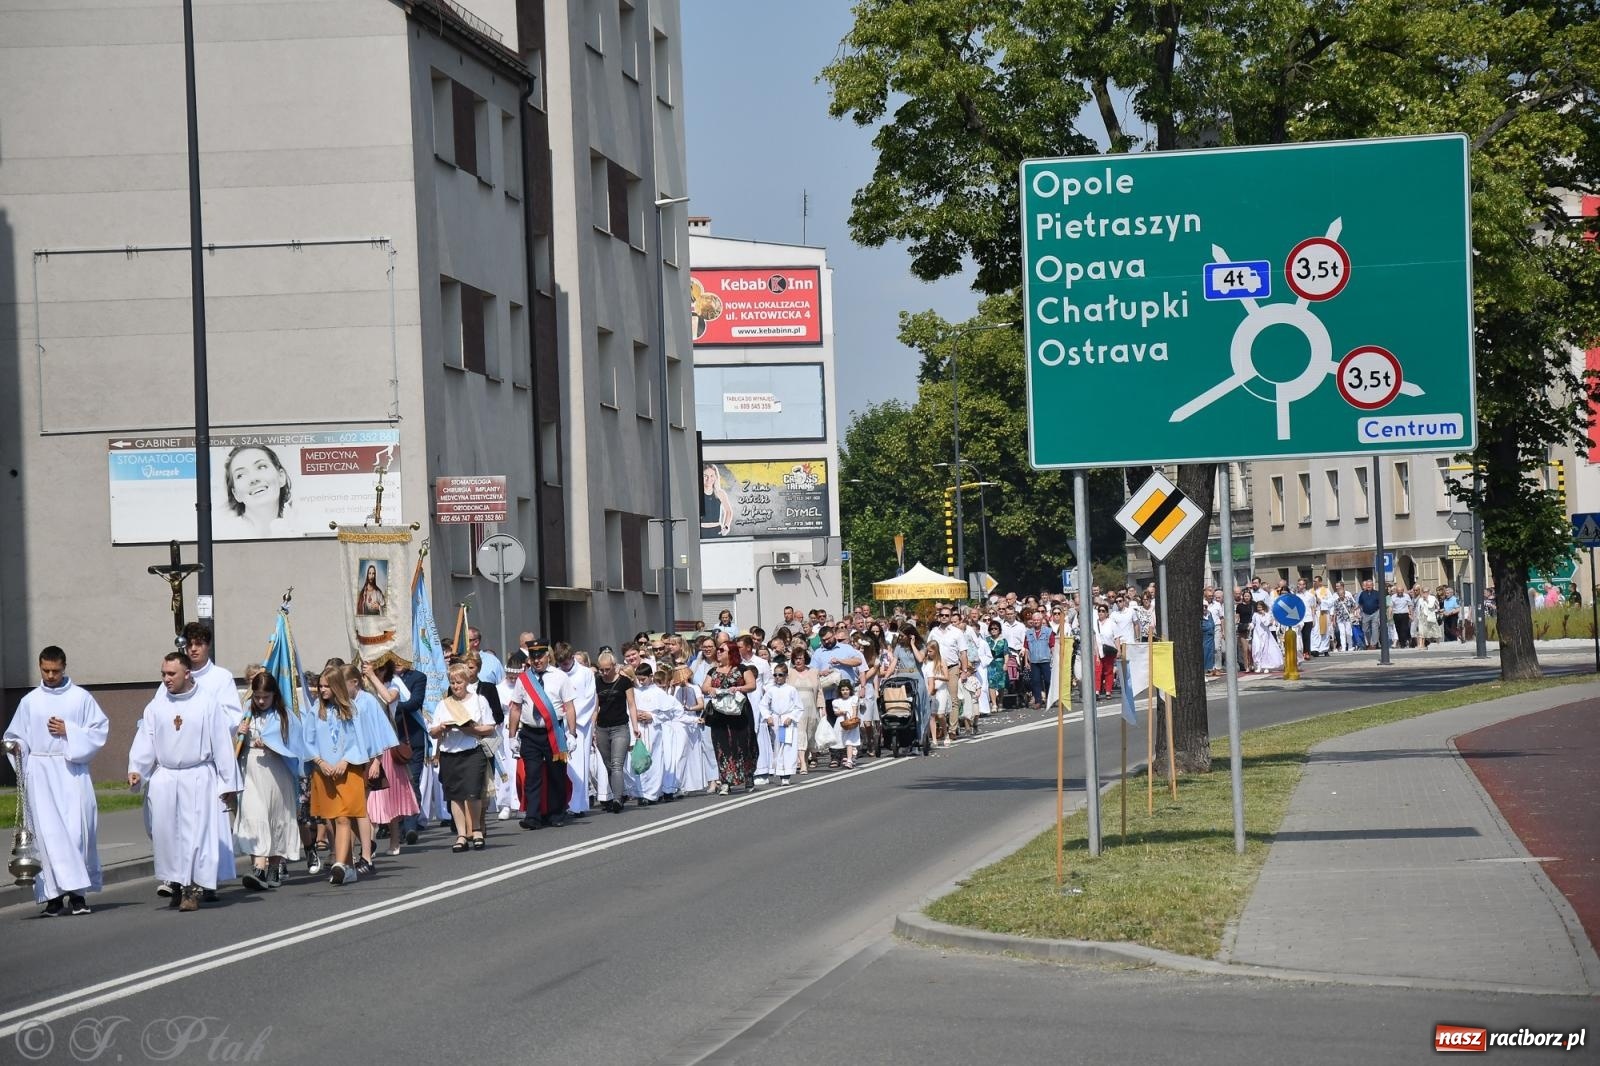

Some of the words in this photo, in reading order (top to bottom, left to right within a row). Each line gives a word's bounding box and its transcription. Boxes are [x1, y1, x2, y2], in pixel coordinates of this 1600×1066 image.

[1032, 168, 1134, 204] Opole
[1036, 213, 1201, 242] Pietraszyn
[1035, 255, 1145, 288] Opava
[1296, 256, 1339, 281] 3,5t
[720, 278, 767, 291] Kebab
[788, 277, 814, 290] Inn
[1223, 270, 1245, 287] 4t
[725, 302, 752, 310] NOWA
[754, 301, 811, 309] LOKALIZACJA
[1037, 291, 1189, 327] Chałupki
[725, 312, 739, 321] ul.
[740, 311, 802, 320] KATOWICKA
[804, 310, 812, 319] 4
[737, 327, 801, 335] www.kebabinn.pl
[1037, 339, 1169, 368] Ostrava
[1347, 366, 1391, 391] 3,5t
[1363, 418, 1459, 440] Centrum
[135, 438, 182, 449] GABINET
[230, 437, 240, 447] K.
[241, 434, 316, 446] SZAL-WIERCZEK
[339, 432, 357, 442] 602
[117, 453, 195, 466] STOMATOLOG
[305, 450, 359, 461] MEDYCYNA
[306, 462, 361, 473] ESTETYCZNA
[451, 478, 492, 486] STOMATOLOGIA
[440, 494, 469, 502] MEDYCYNA
[786, 506, 823, 518] DYMEL
